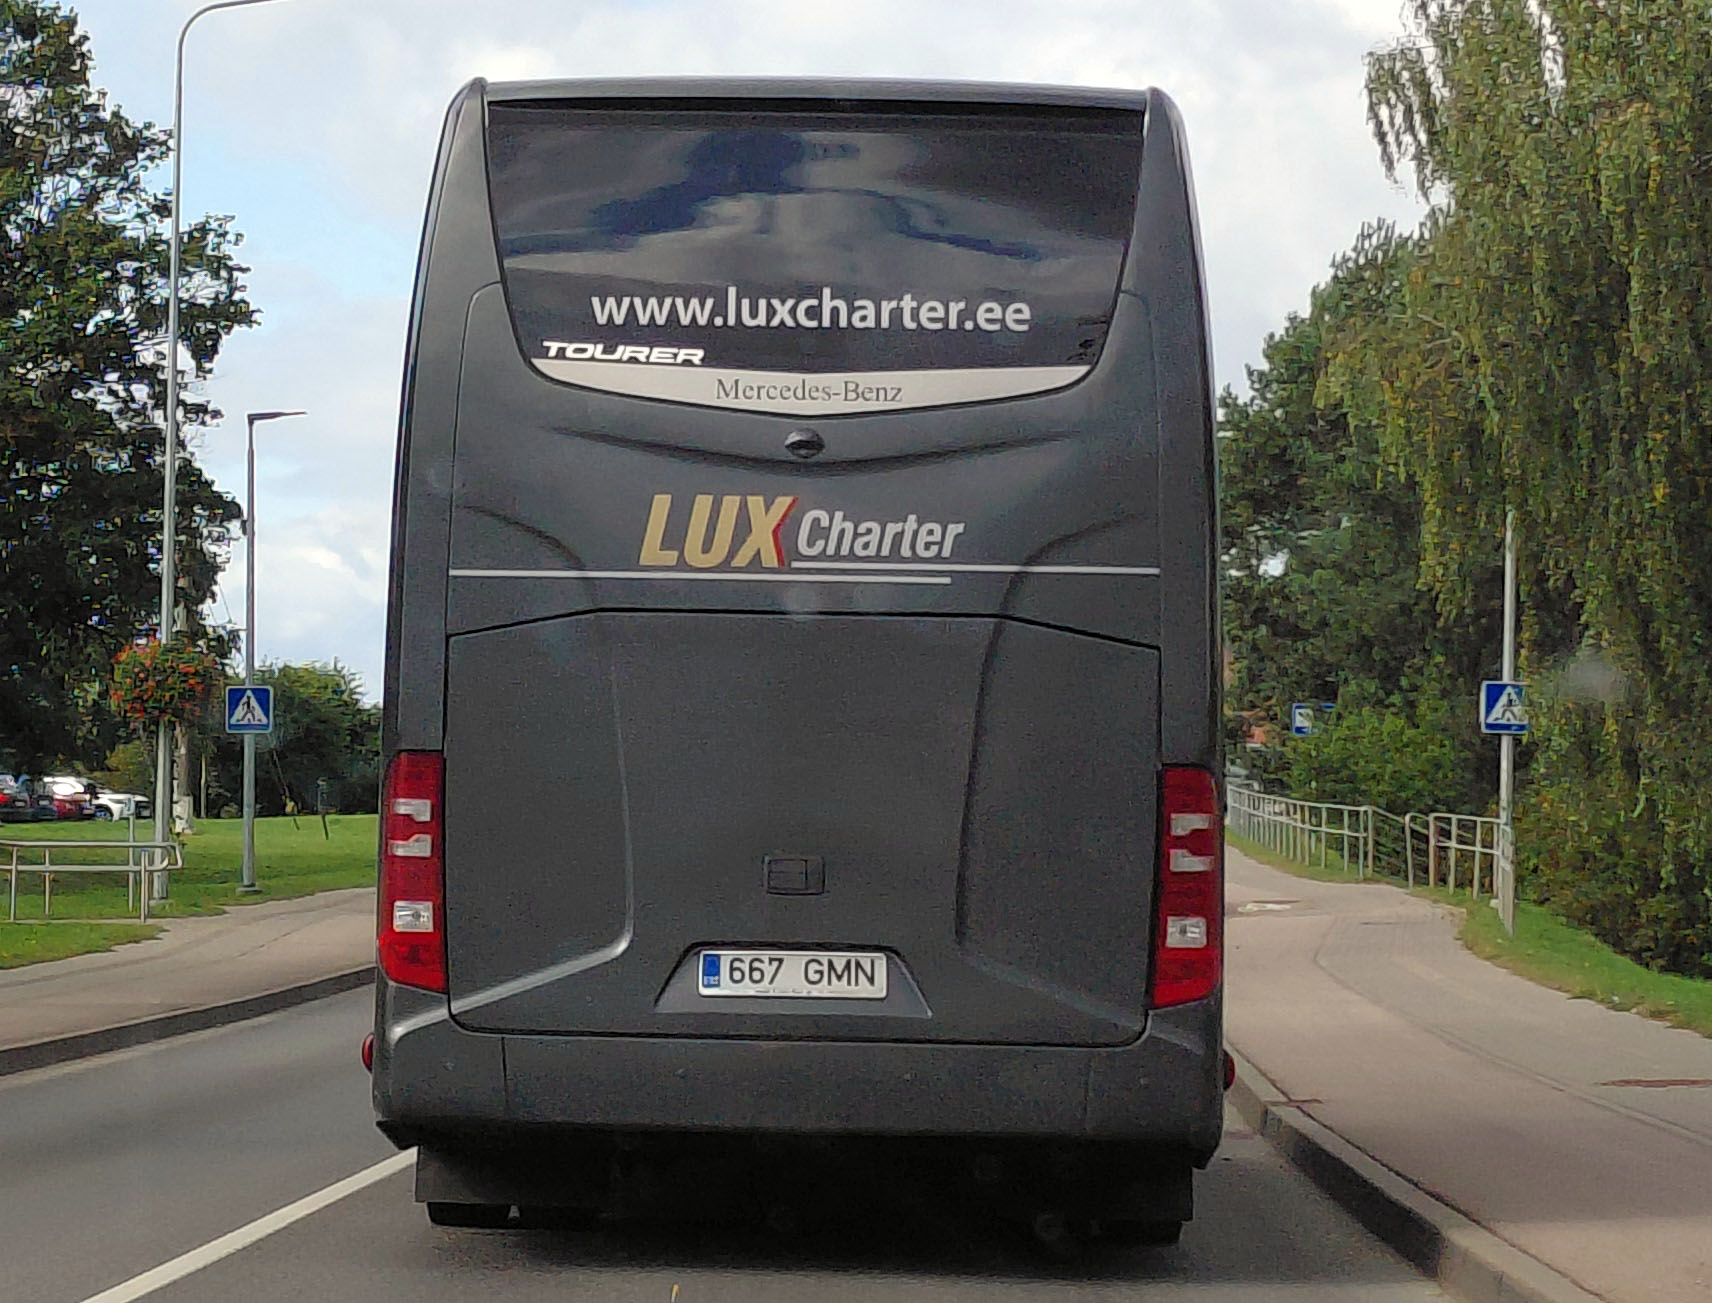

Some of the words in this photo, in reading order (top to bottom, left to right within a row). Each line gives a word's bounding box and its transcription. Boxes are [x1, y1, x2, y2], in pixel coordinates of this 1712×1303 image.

[591, 286, 1032, 332] www.luxcharter.ee
[542, 340, 705, 366] TOURER
[715, 378, 904, 402] Mercedes-Benz
[638, 494, 799, 569] LUX
[797, 509, 965, 559] Charter
[728, 957, 785, 986] 667
[803, 958, 876, 988] GMN
